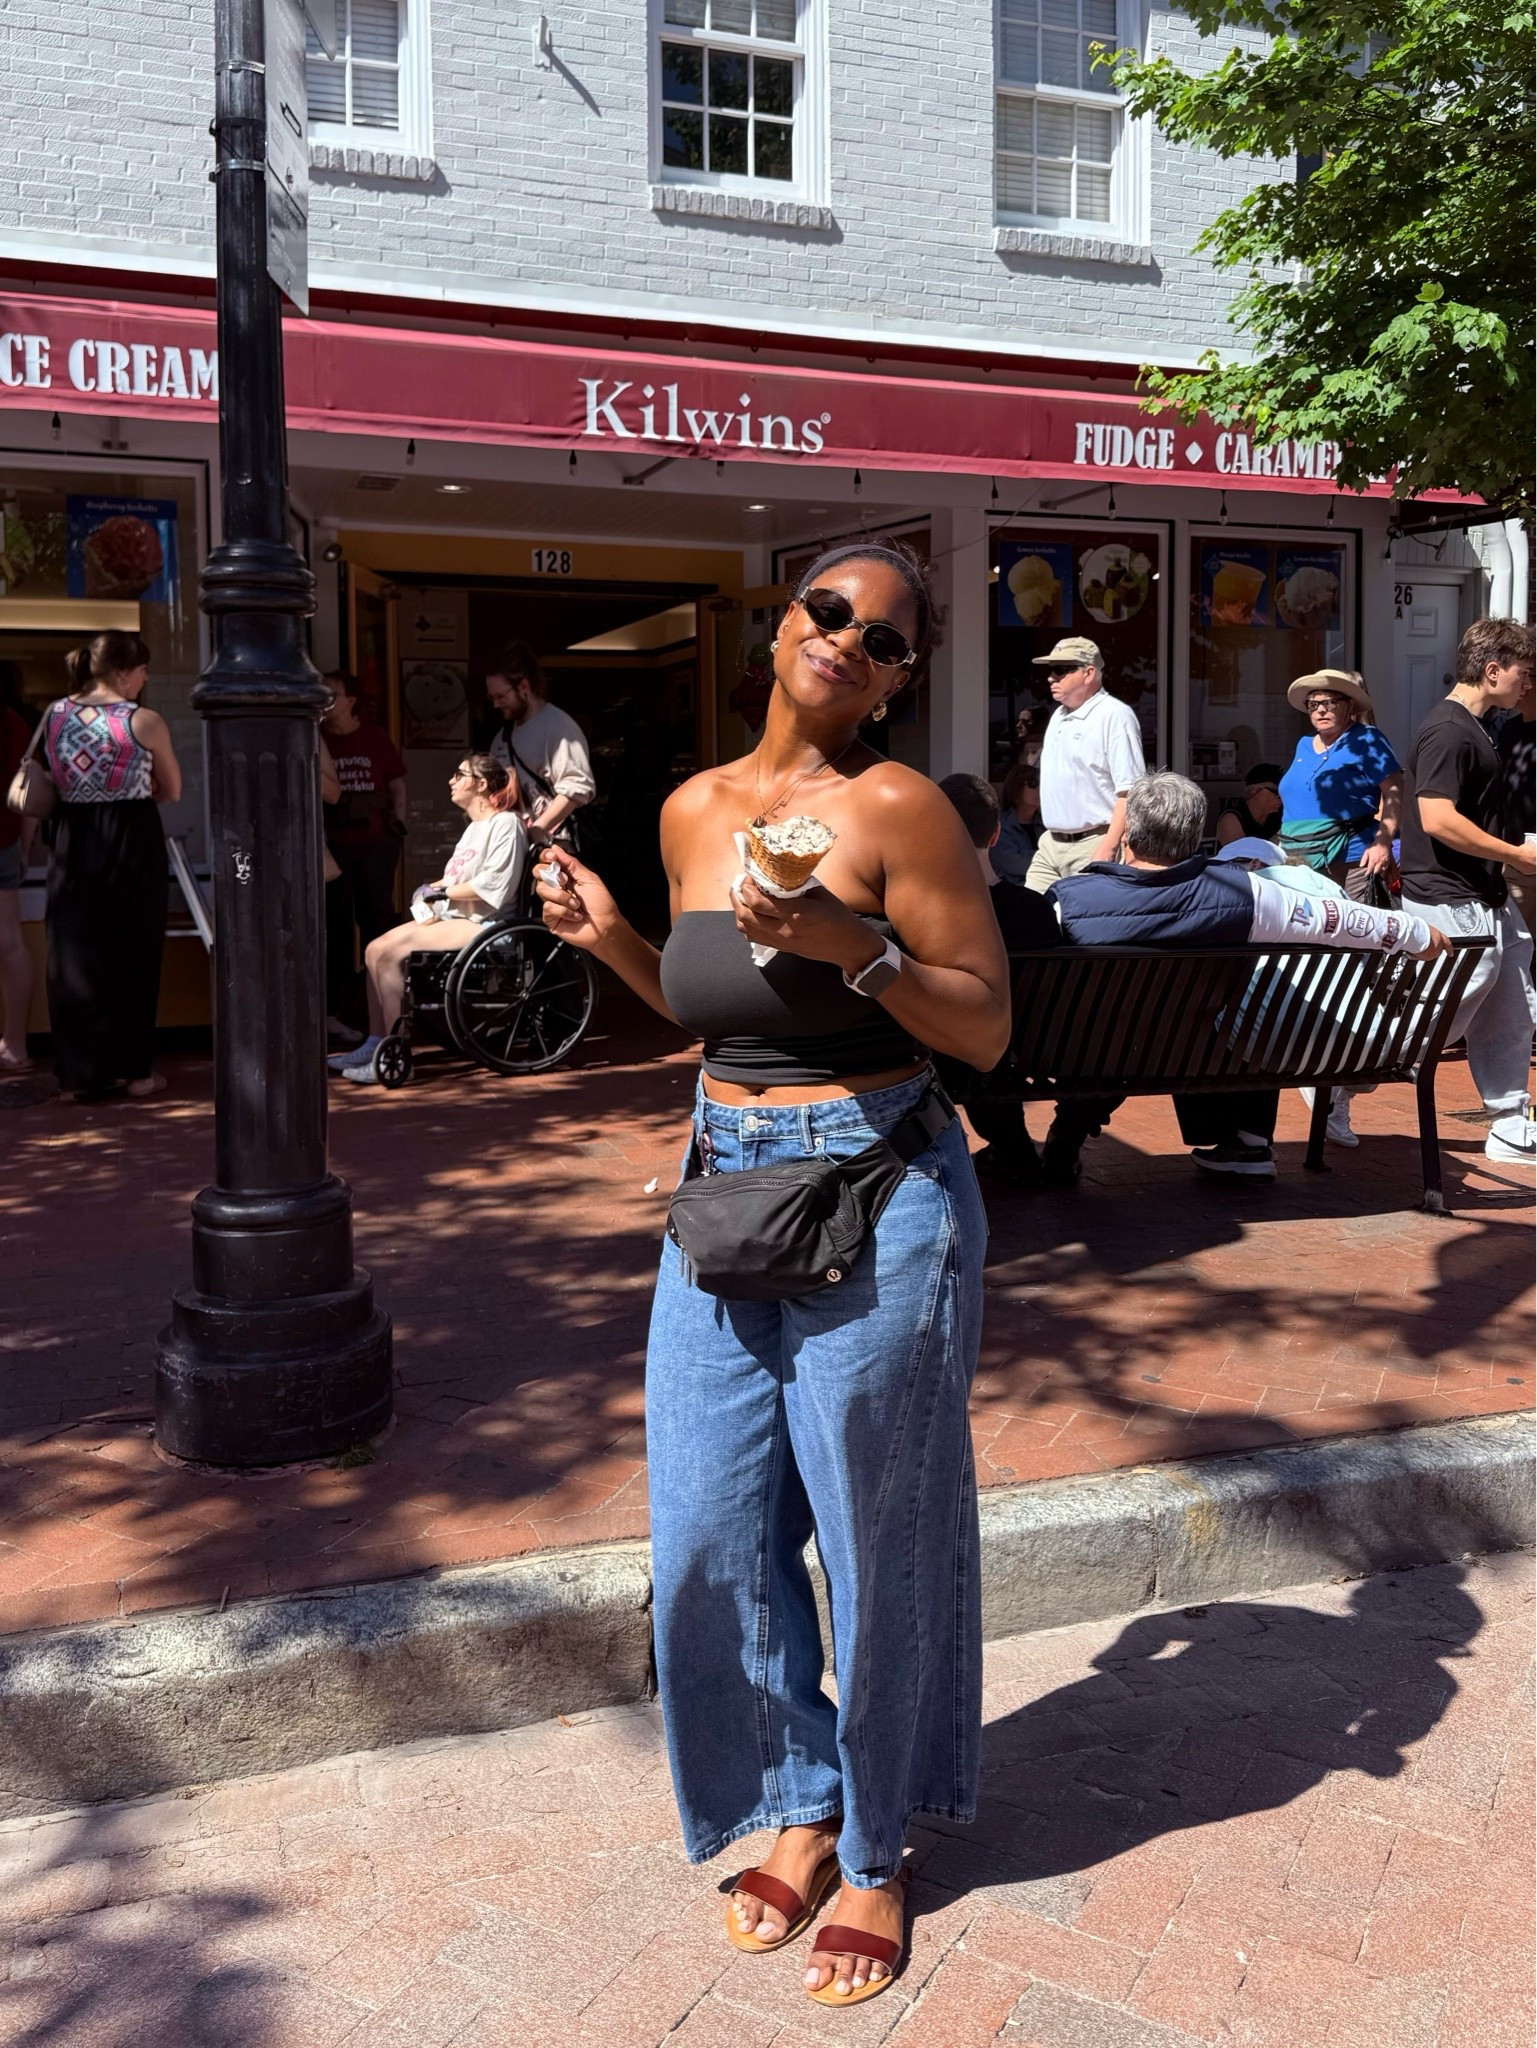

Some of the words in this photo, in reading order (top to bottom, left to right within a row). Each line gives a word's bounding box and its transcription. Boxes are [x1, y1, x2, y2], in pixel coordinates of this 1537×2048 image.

[68, 339, 219, 400] CREAM
[1073, 422, 1175, 469] FUDGE
[534, 550, 571, 574] 128
[1394, 606, 1403, 620] A
[1323, 899, 1339, 934] PHILLIES
[1356, 916, 1366, 930] PHI
